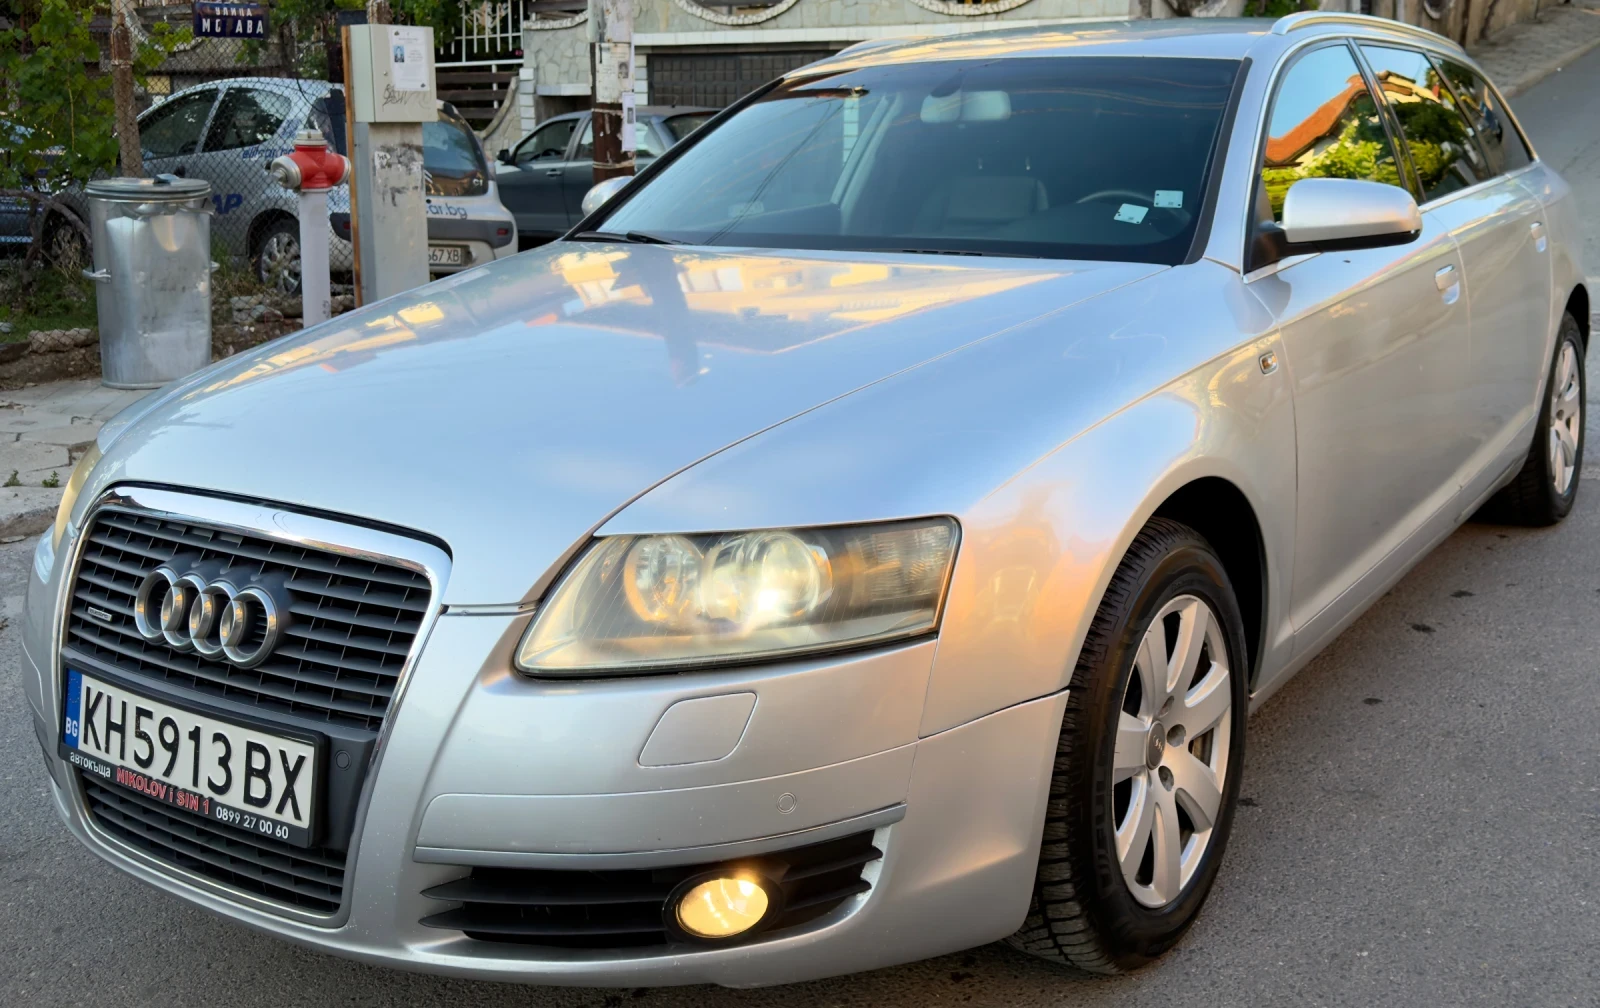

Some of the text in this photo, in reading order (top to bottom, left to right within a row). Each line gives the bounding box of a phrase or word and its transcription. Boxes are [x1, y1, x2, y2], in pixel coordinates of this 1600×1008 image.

[215, 7, 253, 17] УЛИЦА
[65, 716, 79, 738] BG
[69, 751, 112, 779] автокъща
[116, 766, 167, 800] NIKOLOV
[176, 790, 200, 813] SIN
[202, 797, 210, 815] 1
[215, 806, 241, 825] 0899
[243, 814, 257, 830] 27
[259, 821, 273, 835] 00
[275, 825, 289, 840] 60
